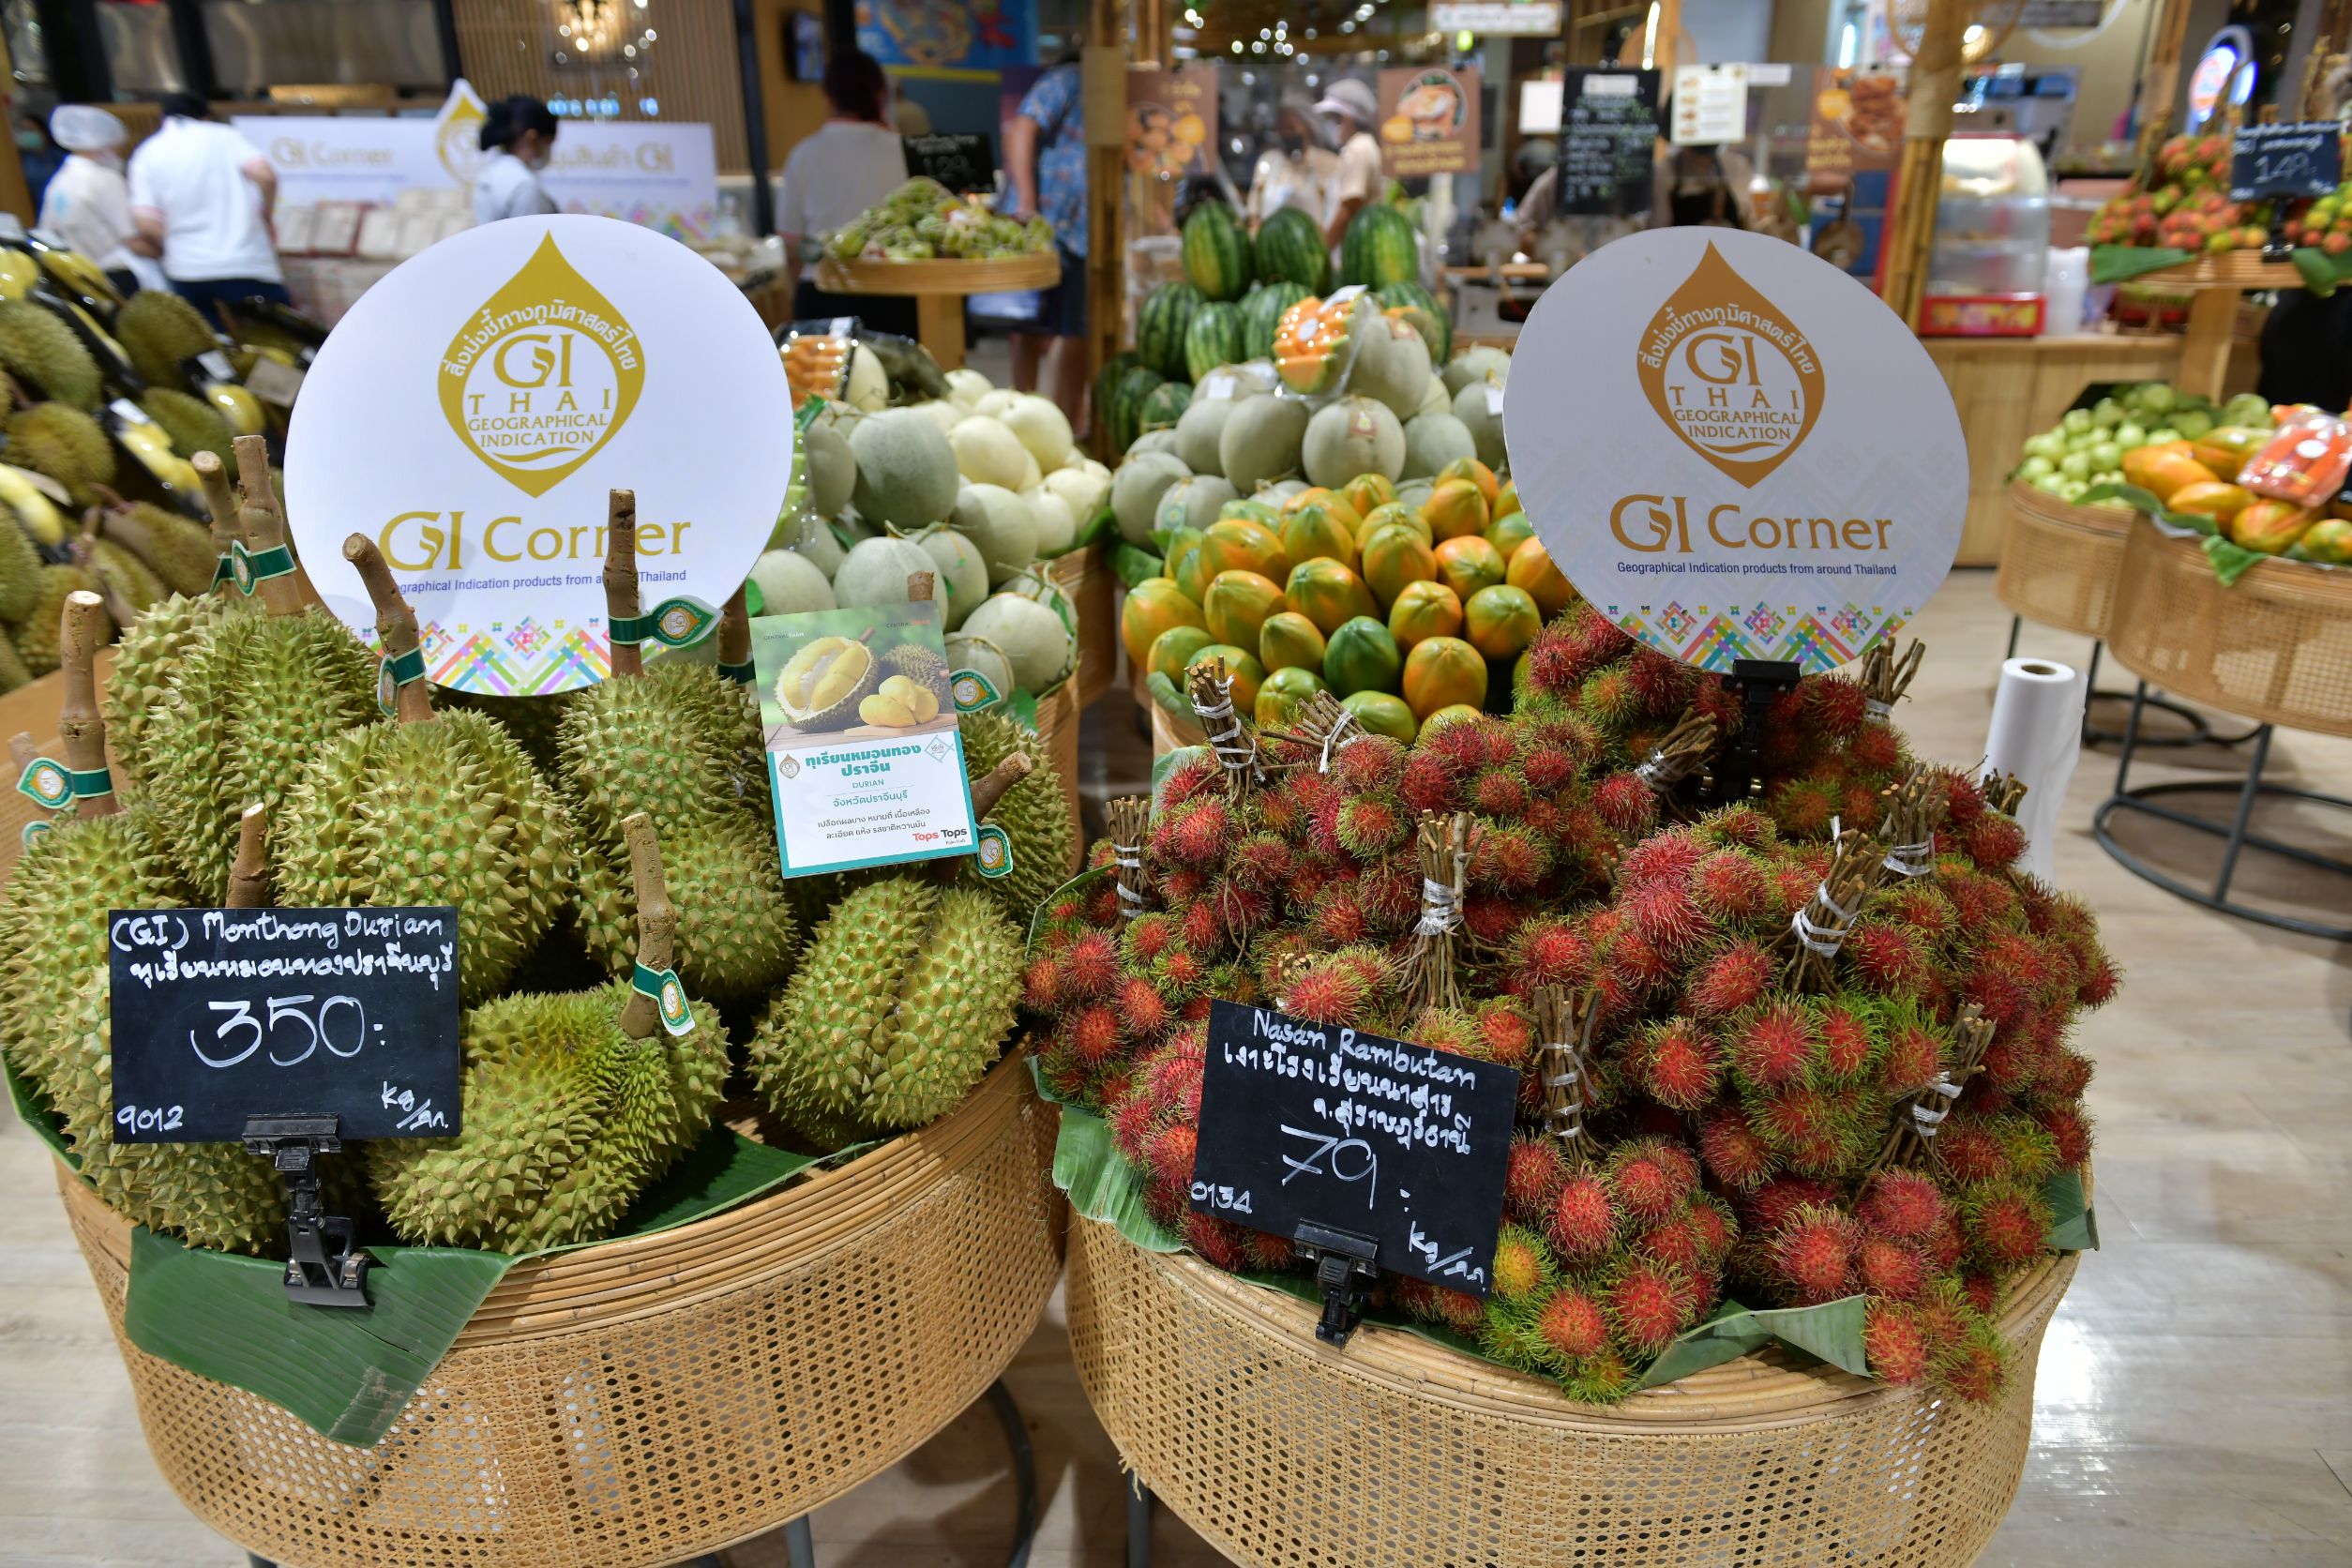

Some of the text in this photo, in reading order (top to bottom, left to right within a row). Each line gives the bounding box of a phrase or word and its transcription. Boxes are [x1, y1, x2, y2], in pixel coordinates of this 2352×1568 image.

[443, 299, 638, 377] สิ่งบ่งชี้ทางภูมิศาสตร์ไทย
[1638, 302, 1817, 374] สิ่งบ่งชี้ทางภูมิศาสตร์ไทย
[493, 333, 576, 389] GI
[1685, 333, 1763, 385] GI
[468, 388, 611, 415] THAI
[1669, 385, 1800, 410] THAI
[468, 413, 609, 431] GEOGRAPHICAL
[1673, 409, 1802, 425] GEOGRAPHICAL
[480, 430, 595, 447] INDICATION
[1688, 425, 1791, 440] INDICATION
[1609, 493, 1892, 553] GI Corner
[378, 509, 466, 572] GI
[455, 579, 509, 591] Indication
[513, 575, 563, 590] products
[565, 574, 593, 586] from
[639, 569, 686, 582] Thailand
[1618, 562, 1897, 575] Geographical Indication products from around Thailand
[805, 744, 922, 770] ทุเรียนหมอนทอง
[840, 761, 891, 777] ปราจีน
[852, 778, 884, 789] DURIAN
[833, 790, 909, 807] จังหวัดปราจีนบุรี
[912, 831, 940, 842] Tops
[941, 828, 968, 838] Tops
[111, 910, 443, 951] (GI) Monthong Durian
[1253, 1008, 1476, 1091] Nasan Rambutan
[117, 1105, 184, 1134] 9012
[1190, 1180, 1252, 1214] 0134
